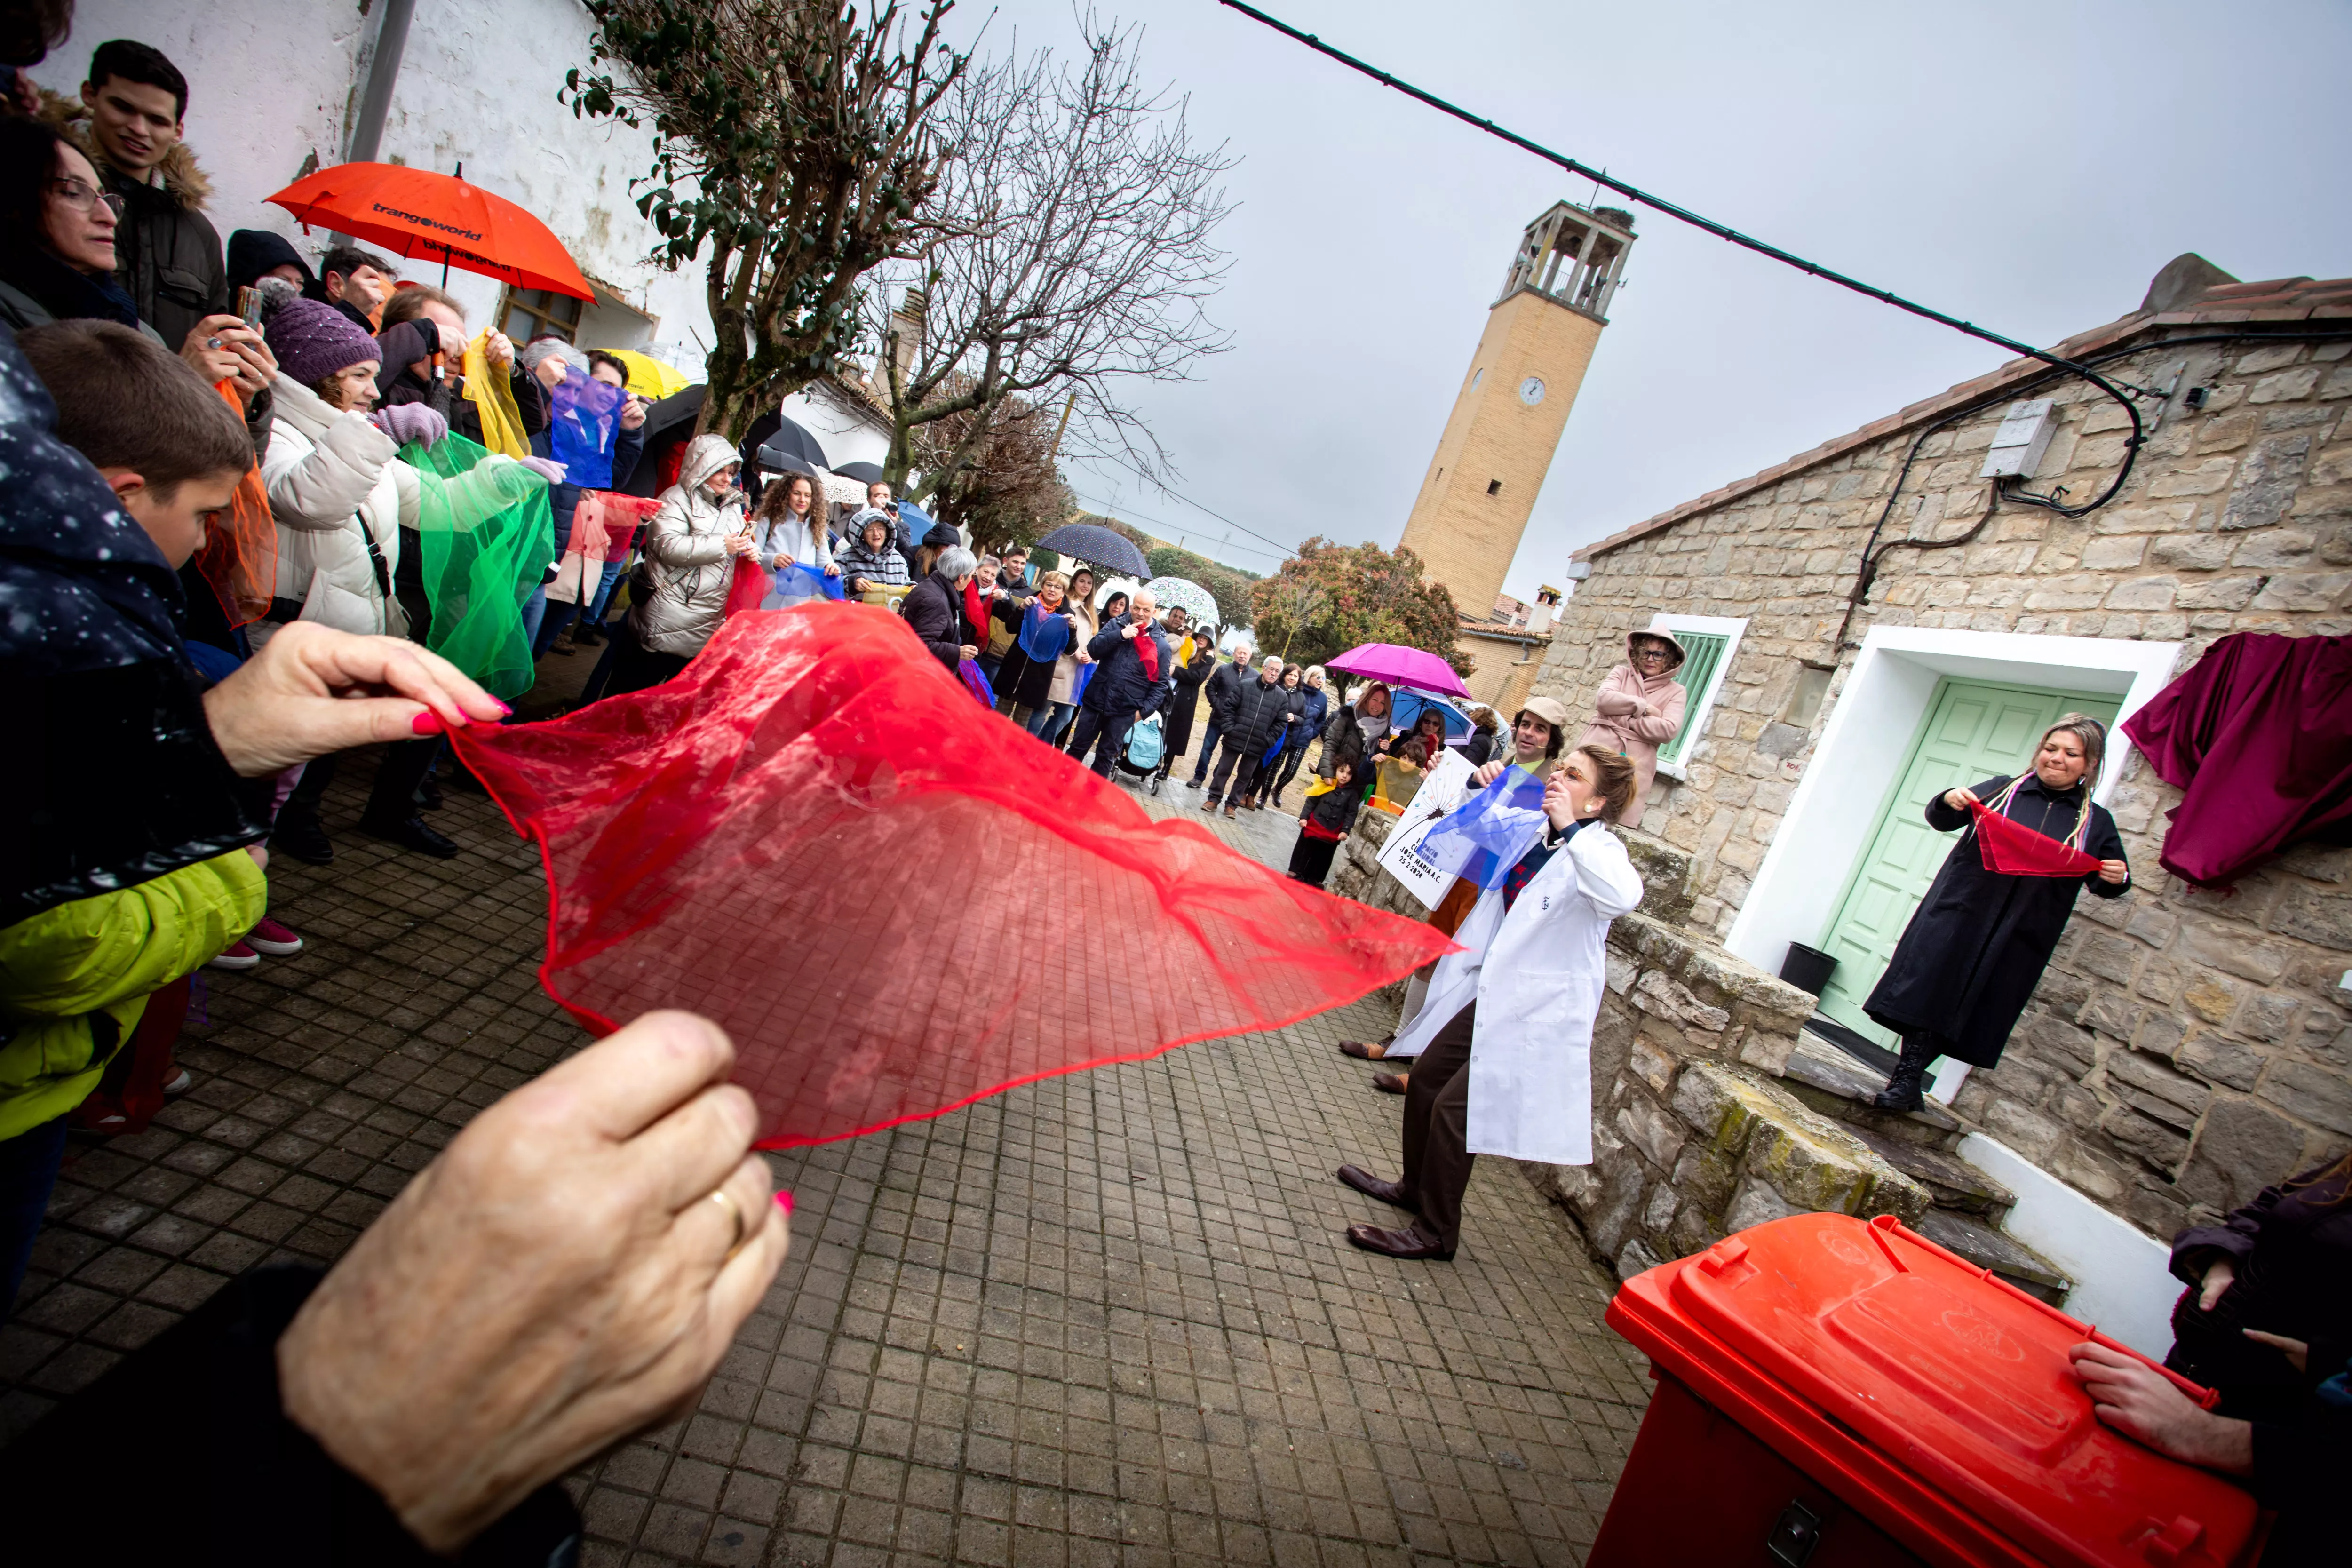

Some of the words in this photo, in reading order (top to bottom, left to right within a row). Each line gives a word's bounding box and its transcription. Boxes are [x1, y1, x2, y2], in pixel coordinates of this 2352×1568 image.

[373, 203, 483, 241] trangoworld
[1411, 844, 1435, 866] CUTURAL
[1416, 838, 1438, 858] EPACIO
[1414, 858, 1431, 875] MARIA
